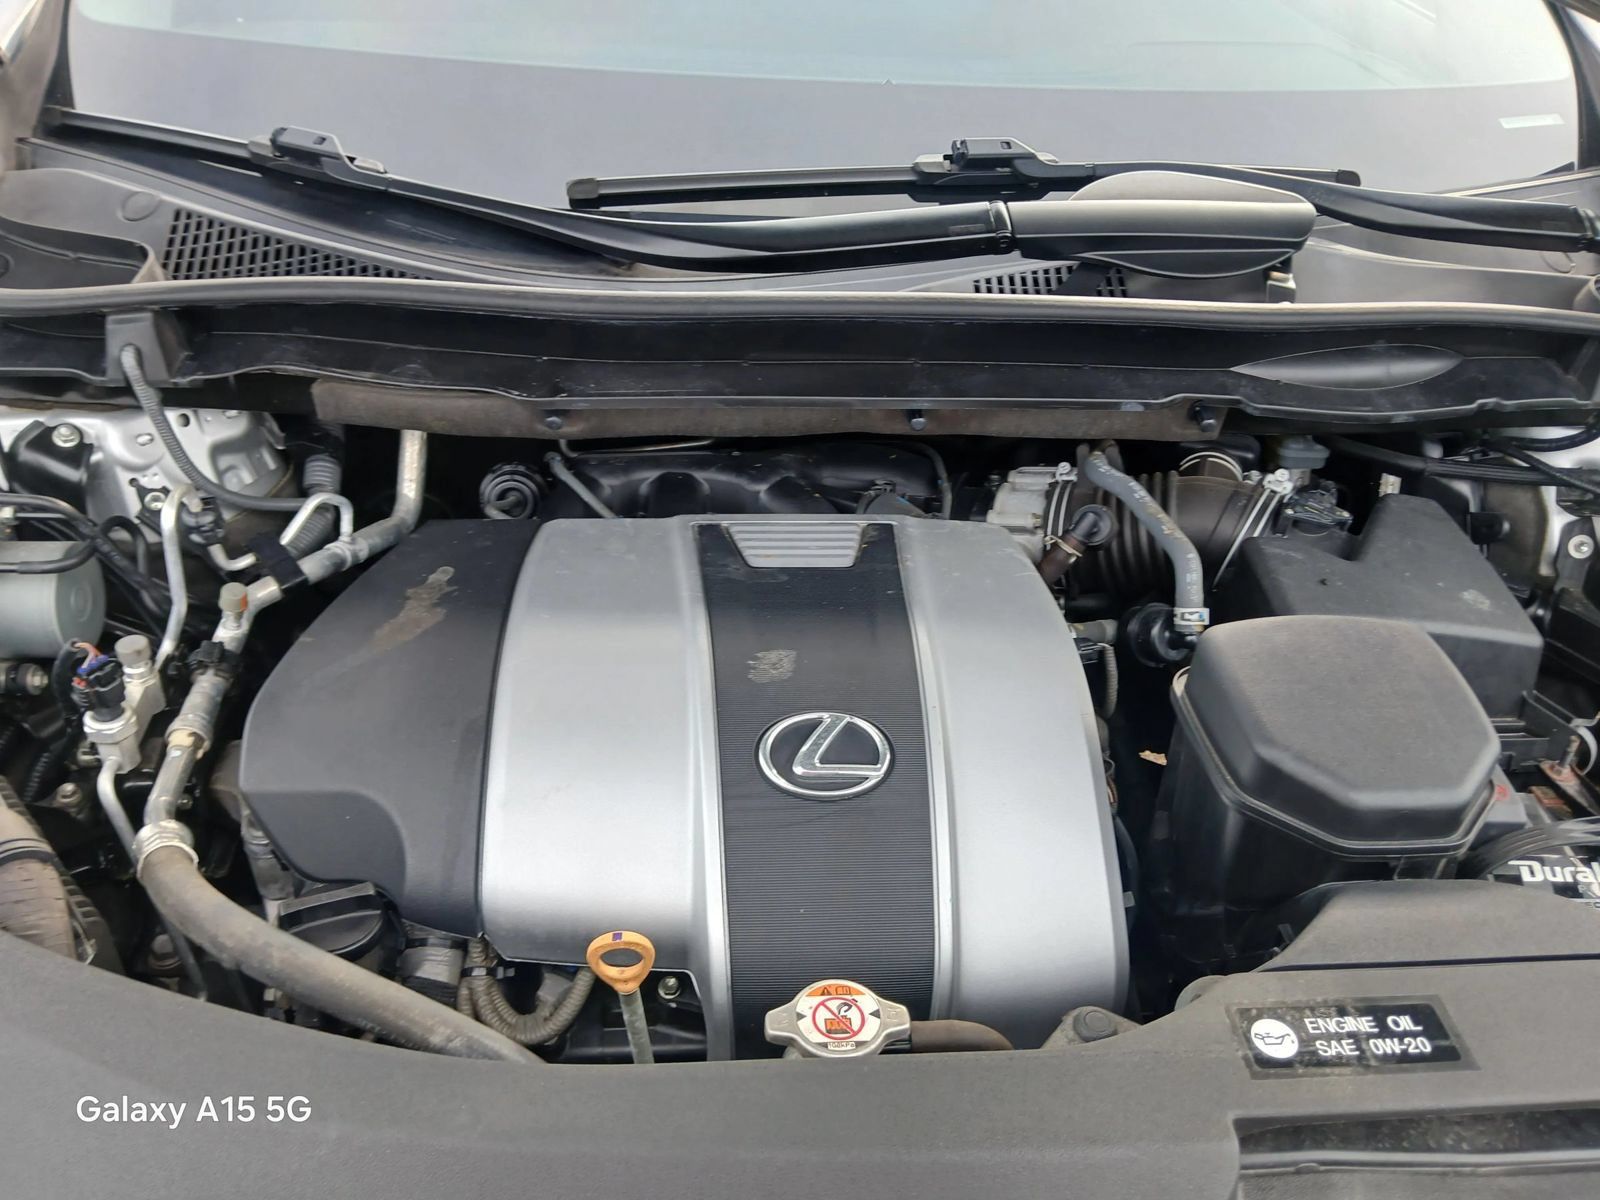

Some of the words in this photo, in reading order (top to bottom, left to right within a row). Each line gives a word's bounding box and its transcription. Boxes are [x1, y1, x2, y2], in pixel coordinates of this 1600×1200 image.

[1304, 1016, 1379, 1034] ENGINE
[1386, 1015, 1423, 1031] OIL
[1315, 1039, 1360, 1056] SAE
[1369, 1037, 1432, 1054] 0W-20
